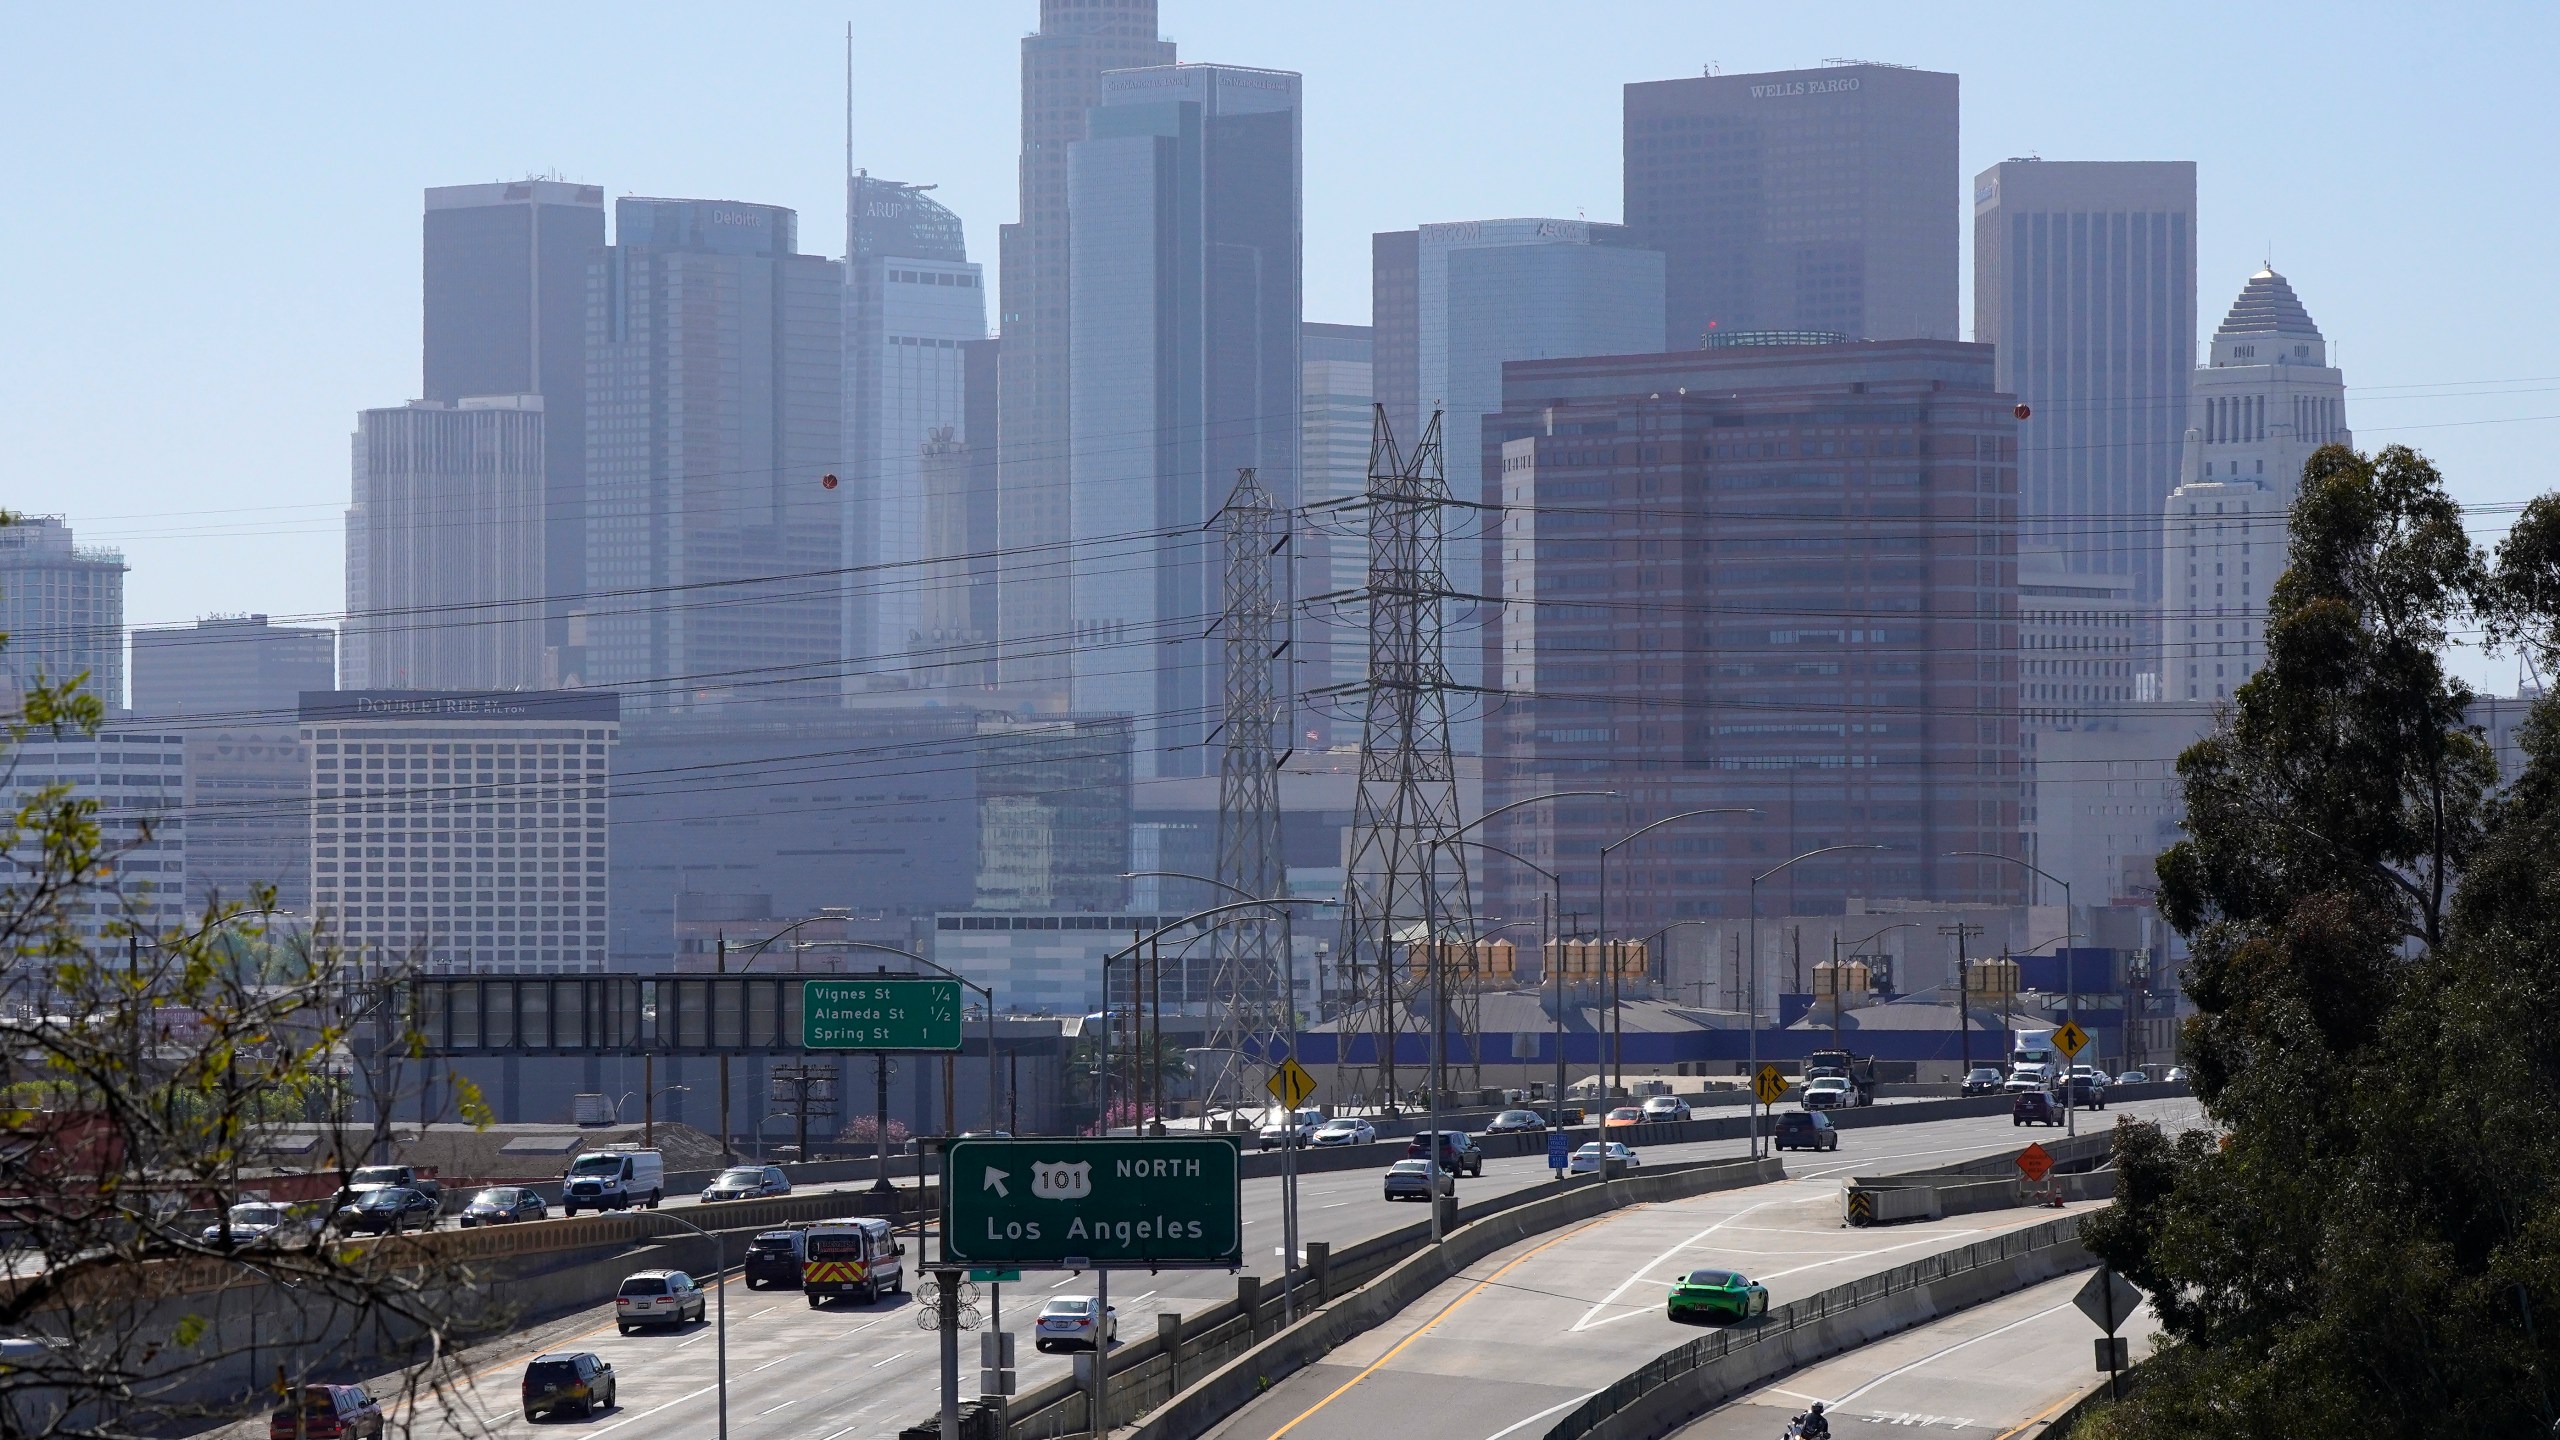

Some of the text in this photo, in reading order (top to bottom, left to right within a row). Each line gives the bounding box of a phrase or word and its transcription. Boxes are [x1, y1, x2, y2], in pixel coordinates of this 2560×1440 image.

[1750, 78, 1860, 98] WELLS FARGO
[867, 201, 903, 218] ARUP
[713, 210, 761, 227] Deloitte
[815, 988, 866, 1003] Vignes
[874, 988, 891, 1000] St
[815, 1008, 881, 1020] Alameda
[889, 1008, 905, 1020] St
[814, 1027, 928, 1042] Spring St 1
[1041, 1159, 1200, 1189] 101 NORTH
[987, 1215, 1203, 1249] Los Angeles
